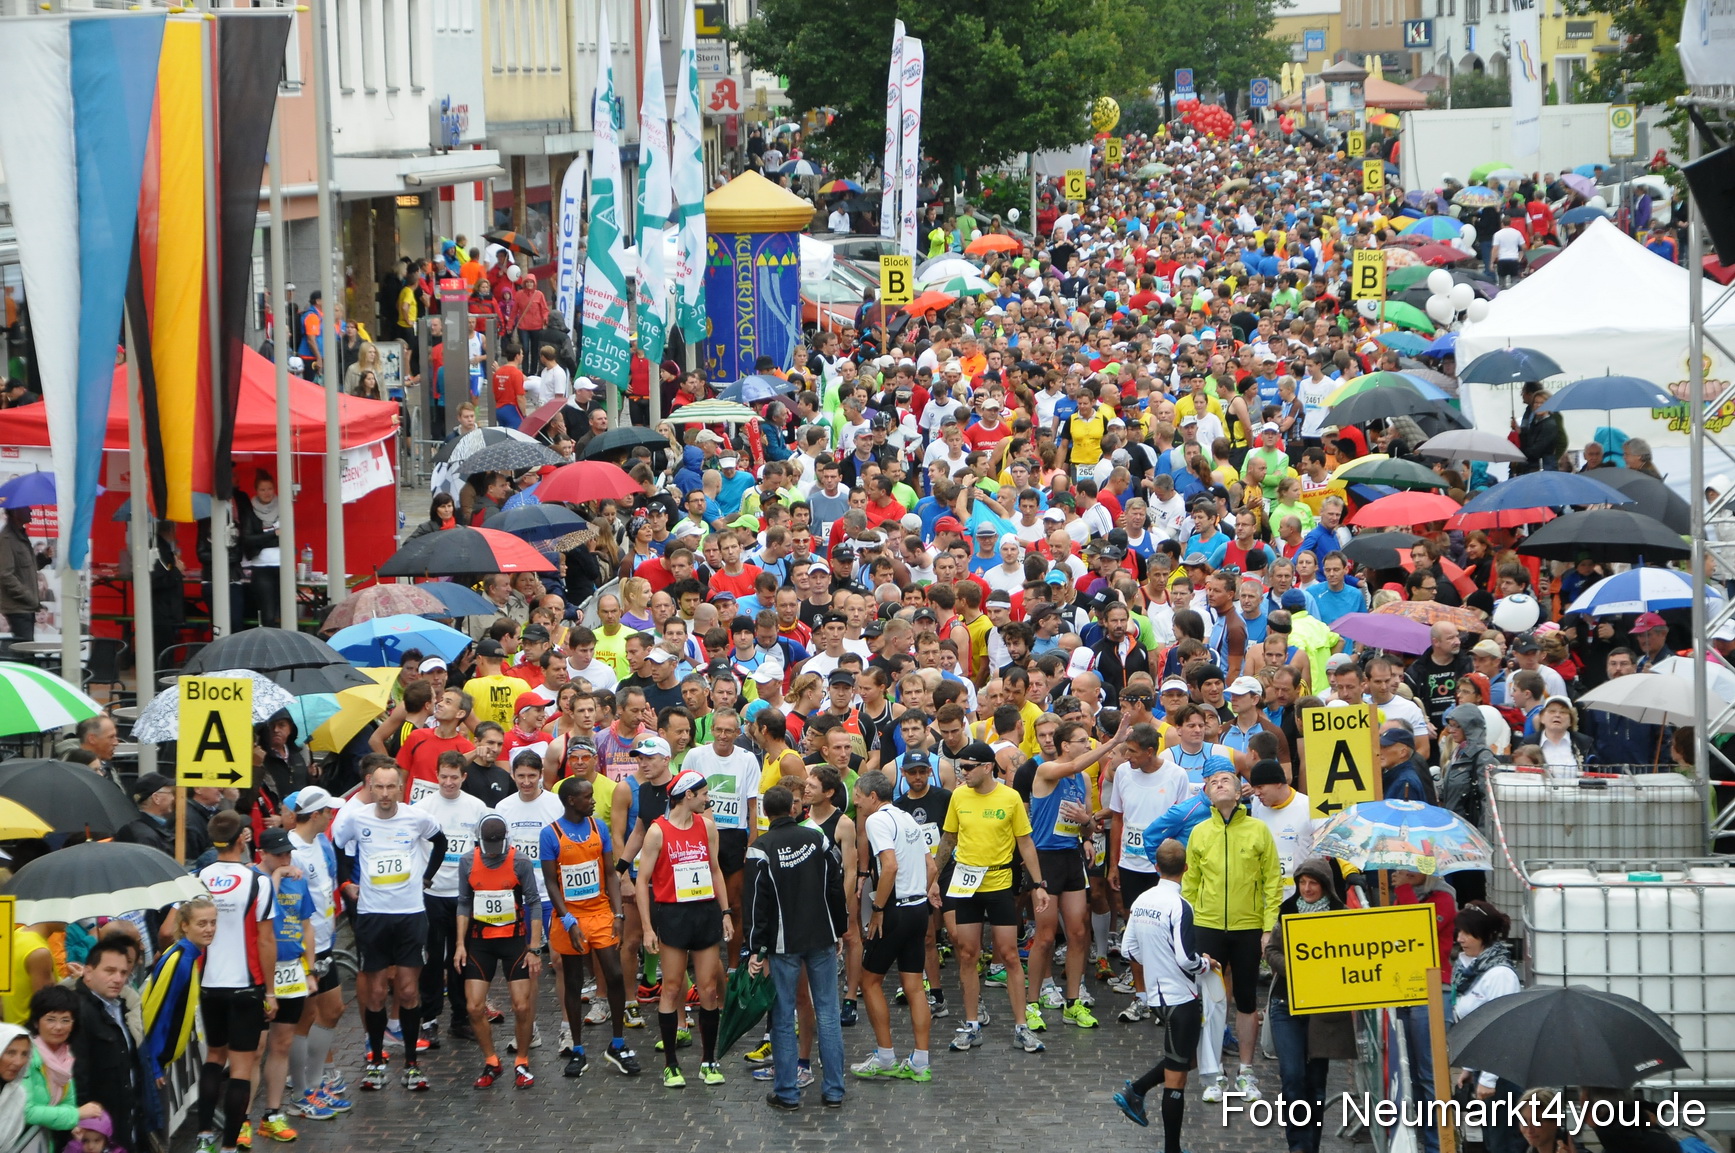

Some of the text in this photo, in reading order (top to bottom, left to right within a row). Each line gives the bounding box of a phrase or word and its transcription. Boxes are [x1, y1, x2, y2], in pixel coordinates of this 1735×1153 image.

[1109, 145, 1118, 158] D
[1353, 137, 1362, 151] D
[1368, 169, 1379, 185] C
[1070, 178, 1080, 193] C
[883, 257, 909, 267] Block
[1357, 252, 1384, 262] Block
[888, 270, 905, 294] B
[1361, 265, 1378, 289] B
[584, 352, 620, 376] 6352
[1305, 396, 1321, 404] 2461
[186, 681, 244, 701] Block
[490, 685, 511, 702] MTP
[1311, 709, 1370, 732] Block
[193, 710, 235, 763] A
[1323, 739, 1366, 794] A
[710, 801, 738, 815] 2740
[448, 840, 466, 853] 37
[924, 832, 933, 846] 3
[778, 846, 791, 855] LLC
[779, 843, 808, 862] Marathon
[780, 842, 817, 868] Regensburg
[377, 859, 403, 874] 578
[209, 876, 232, 887] tkn
[566, 870, 597, 888] 2001
[692, 872, 699, 885] 4
[962, 873, 977, 886] 99
[573, 887, 595, 897] Zachary
[486, 900, 502, 914] 98
[1133, 908, 1161, 921] ERDINGER
[1295, 938, 1424, 961] Schnupper-
[275, 968, 299, 985] 322
[1342, 963, 1382, 984] lauf
